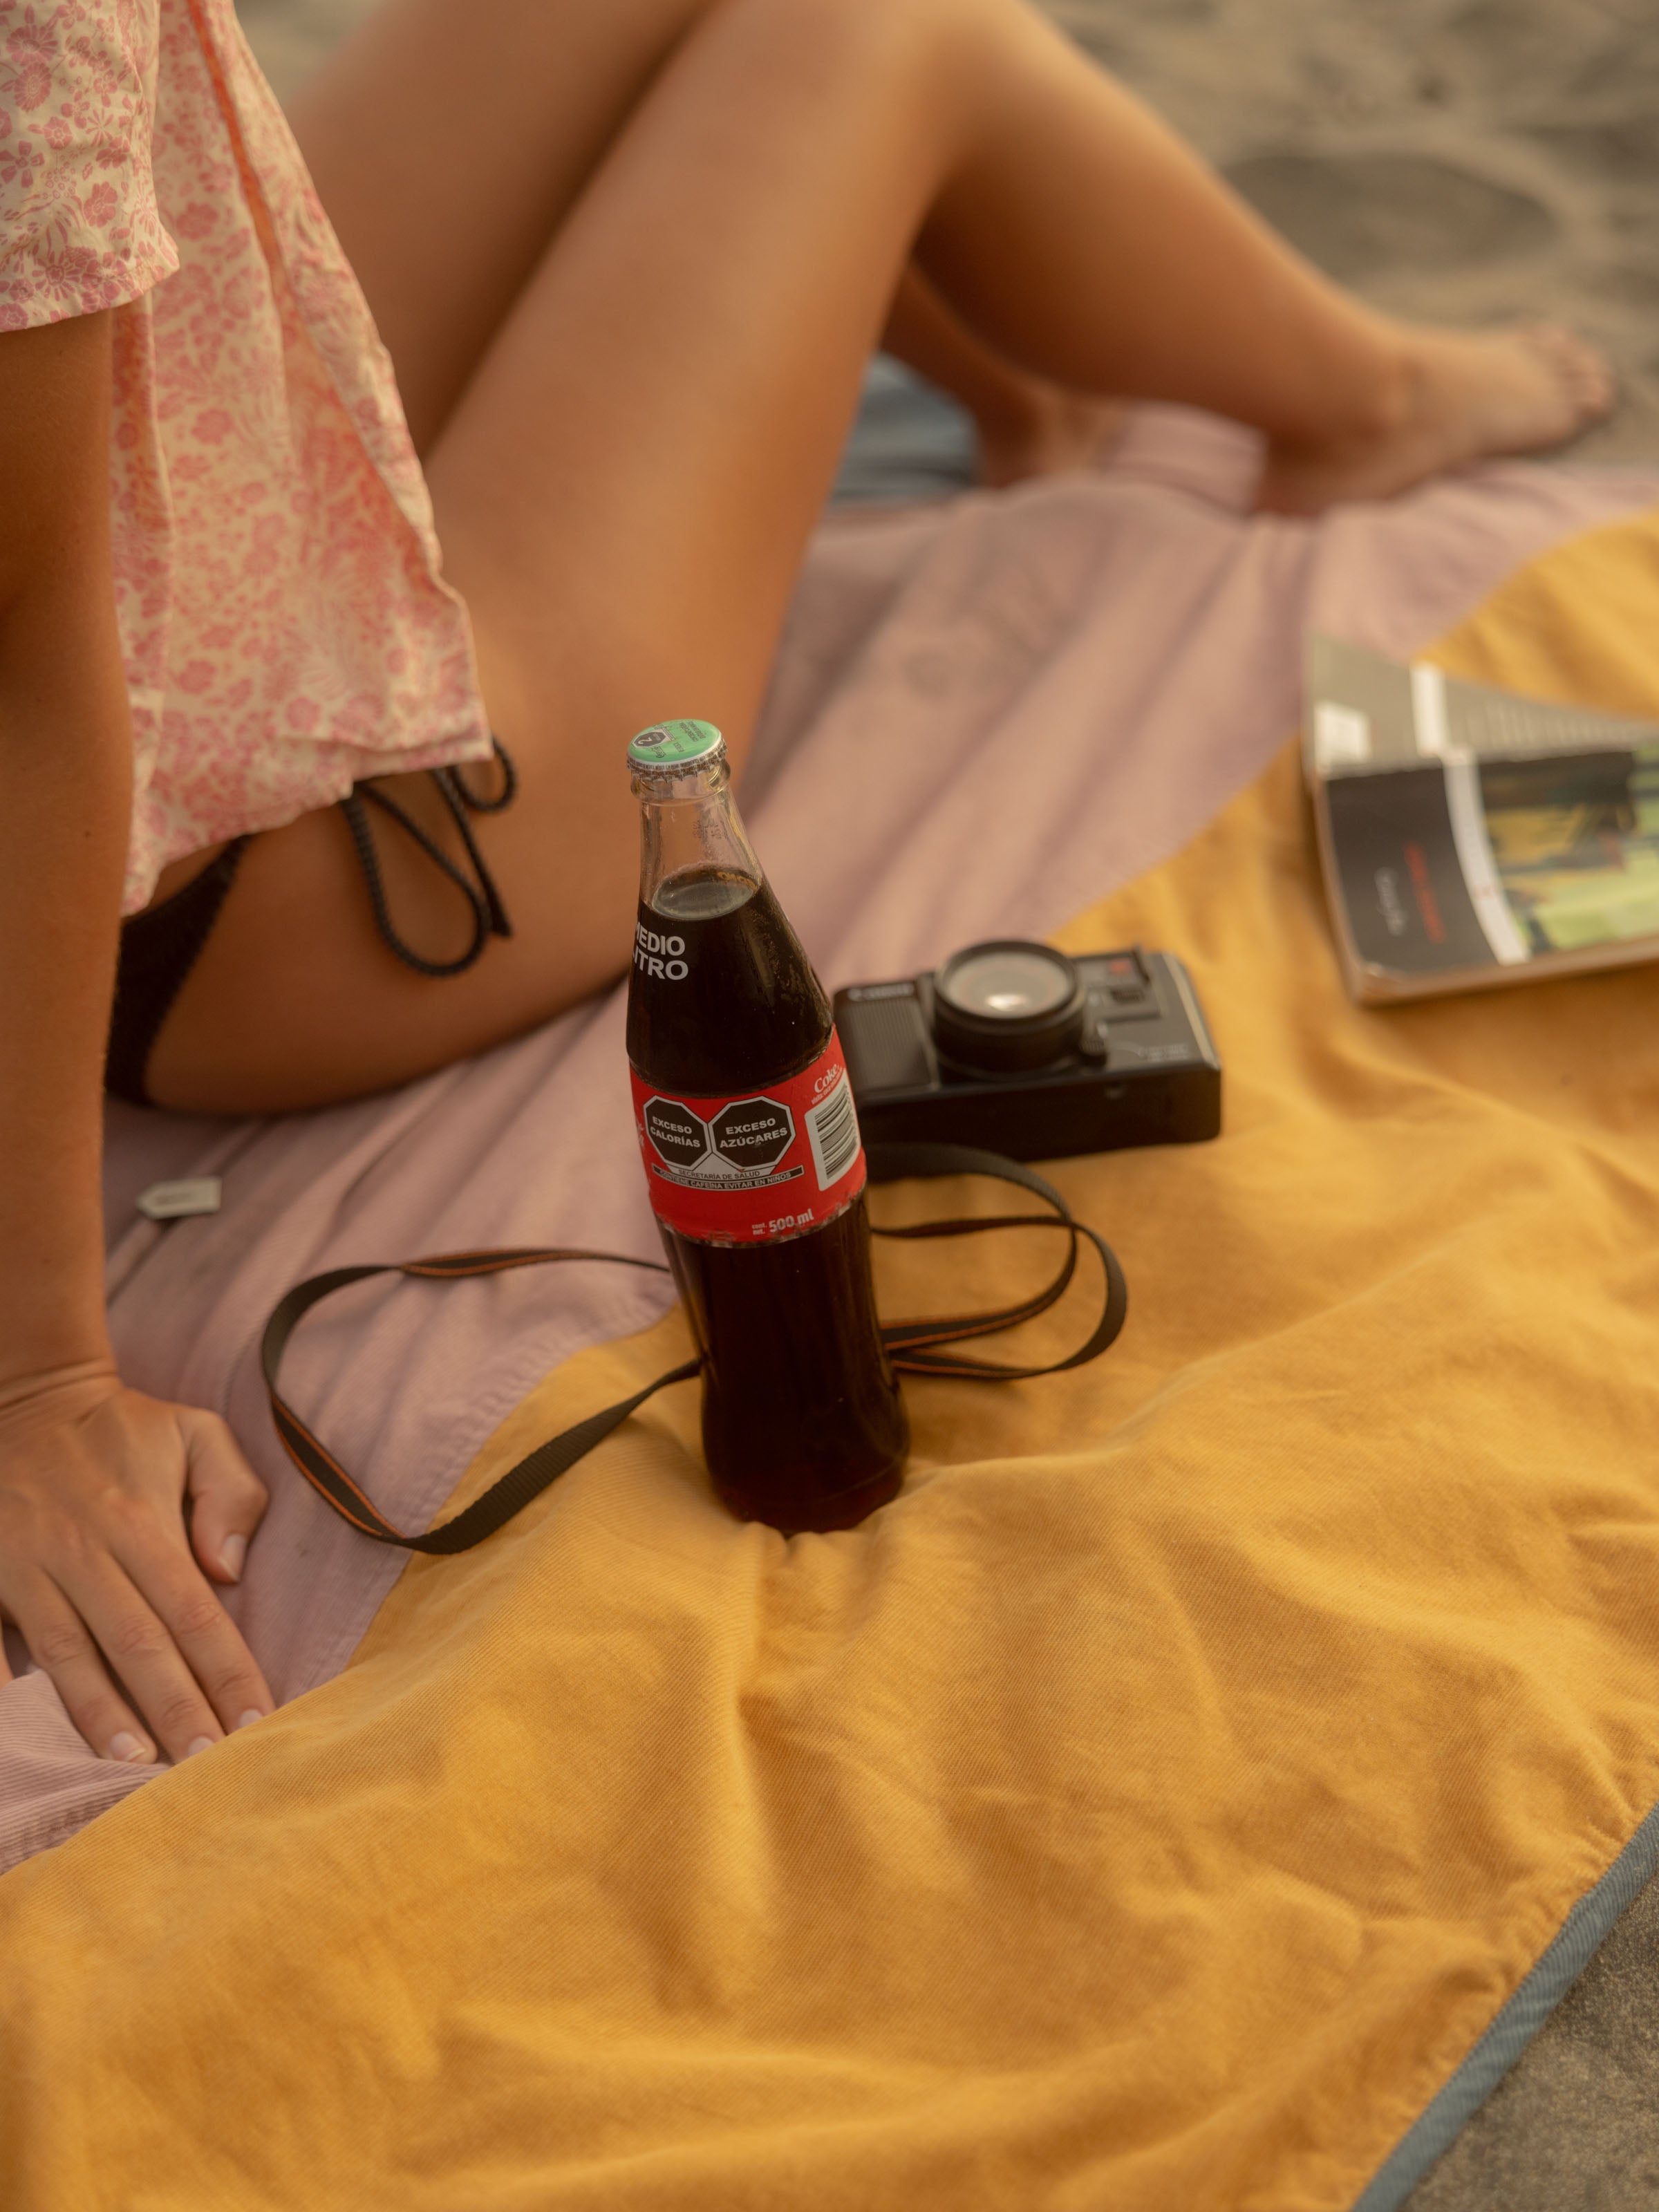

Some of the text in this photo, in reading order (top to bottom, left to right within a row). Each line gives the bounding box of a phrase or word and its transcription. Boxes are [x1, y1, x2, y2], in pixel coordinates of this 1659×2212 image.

[633, 945, 689, 980] ITRO
[814, 1064, 838, 1093] Coke
[653, 1116, 692, 1134] EXCESO
[725, 1118, 776, 1135] EXCESO
[650, 1127, 701, 1147] CALORÍAS
[720, 1127, 788, 1148] AZÚCARES
[679, 1170, 722, 1179] SECRETARÍA
[735, 1171, 760, 1179] SALUD
[769, 1208, 814, 1232] 500 ml
